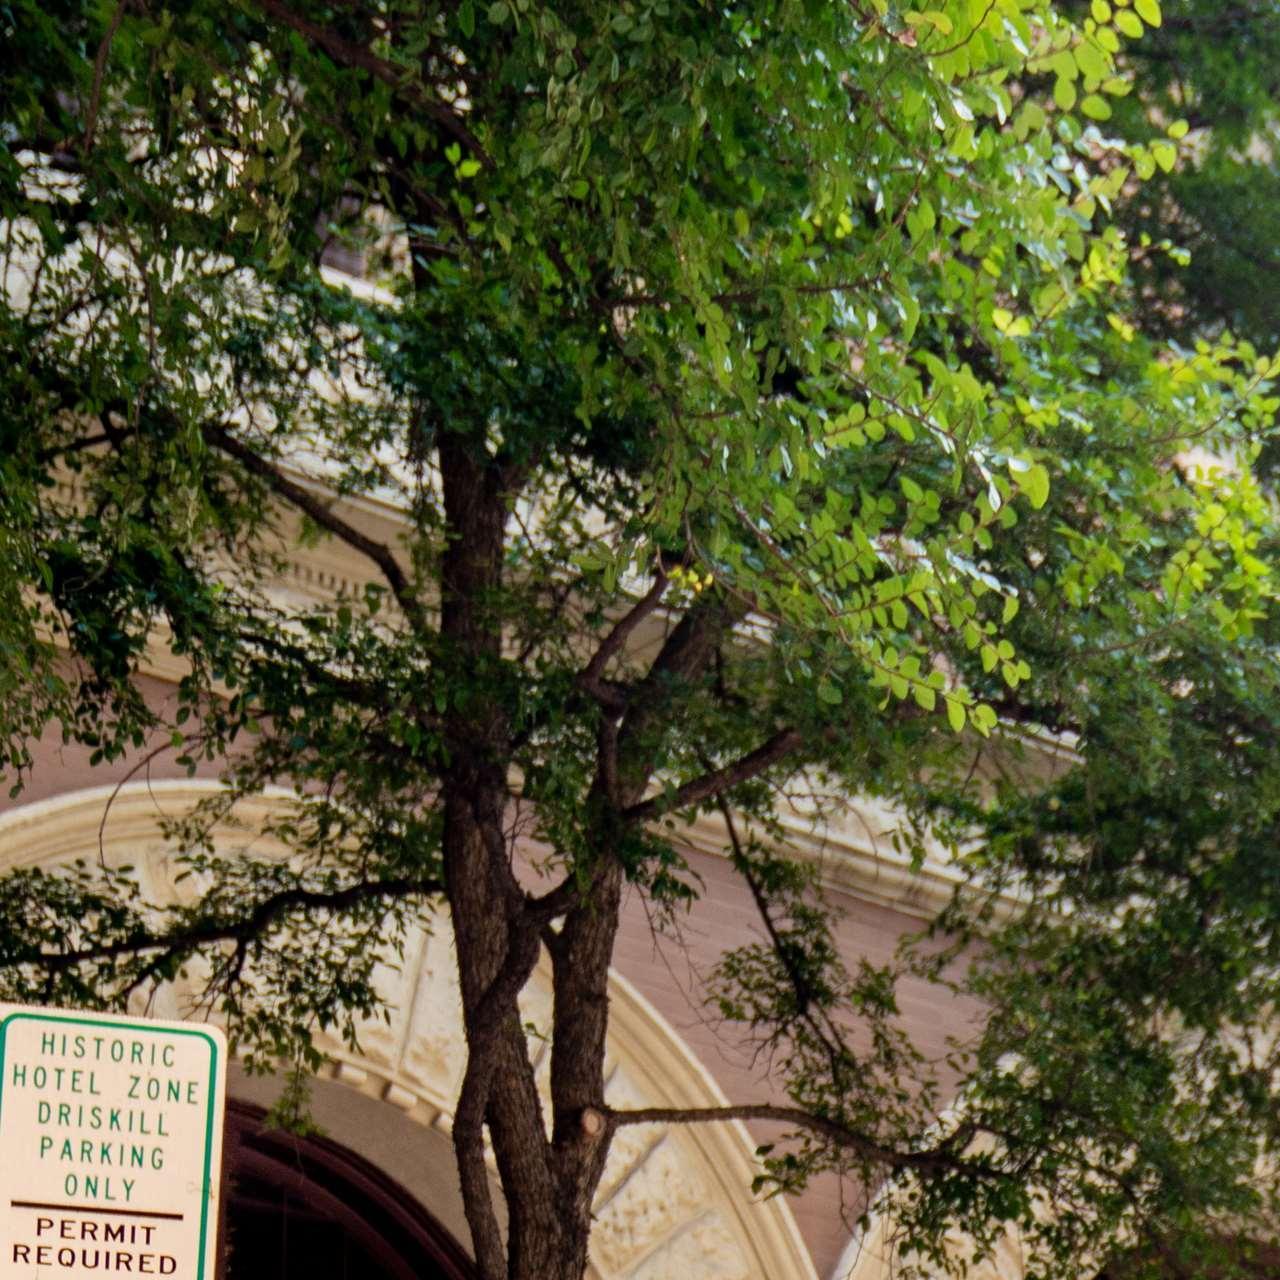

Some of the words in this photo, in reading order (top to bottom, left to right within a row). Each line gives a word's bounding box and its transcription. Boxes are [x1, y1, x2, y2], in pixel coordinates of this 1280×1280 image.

[41, 1032, 176, 1068] HISTORIC
[13, 1063, 101, 1096] HOTEL
[127, 1075, 200, 1105] ZONE
[38, 1100, 170, 1137] DRISKILL
[40, 1135, 164, 1171] PARKING
[64, 1173, 135, 1201] ONLY
[36, 1217, 157, 1246] PERMIT
[12, 1243, 178, 1275] REQUIRED
